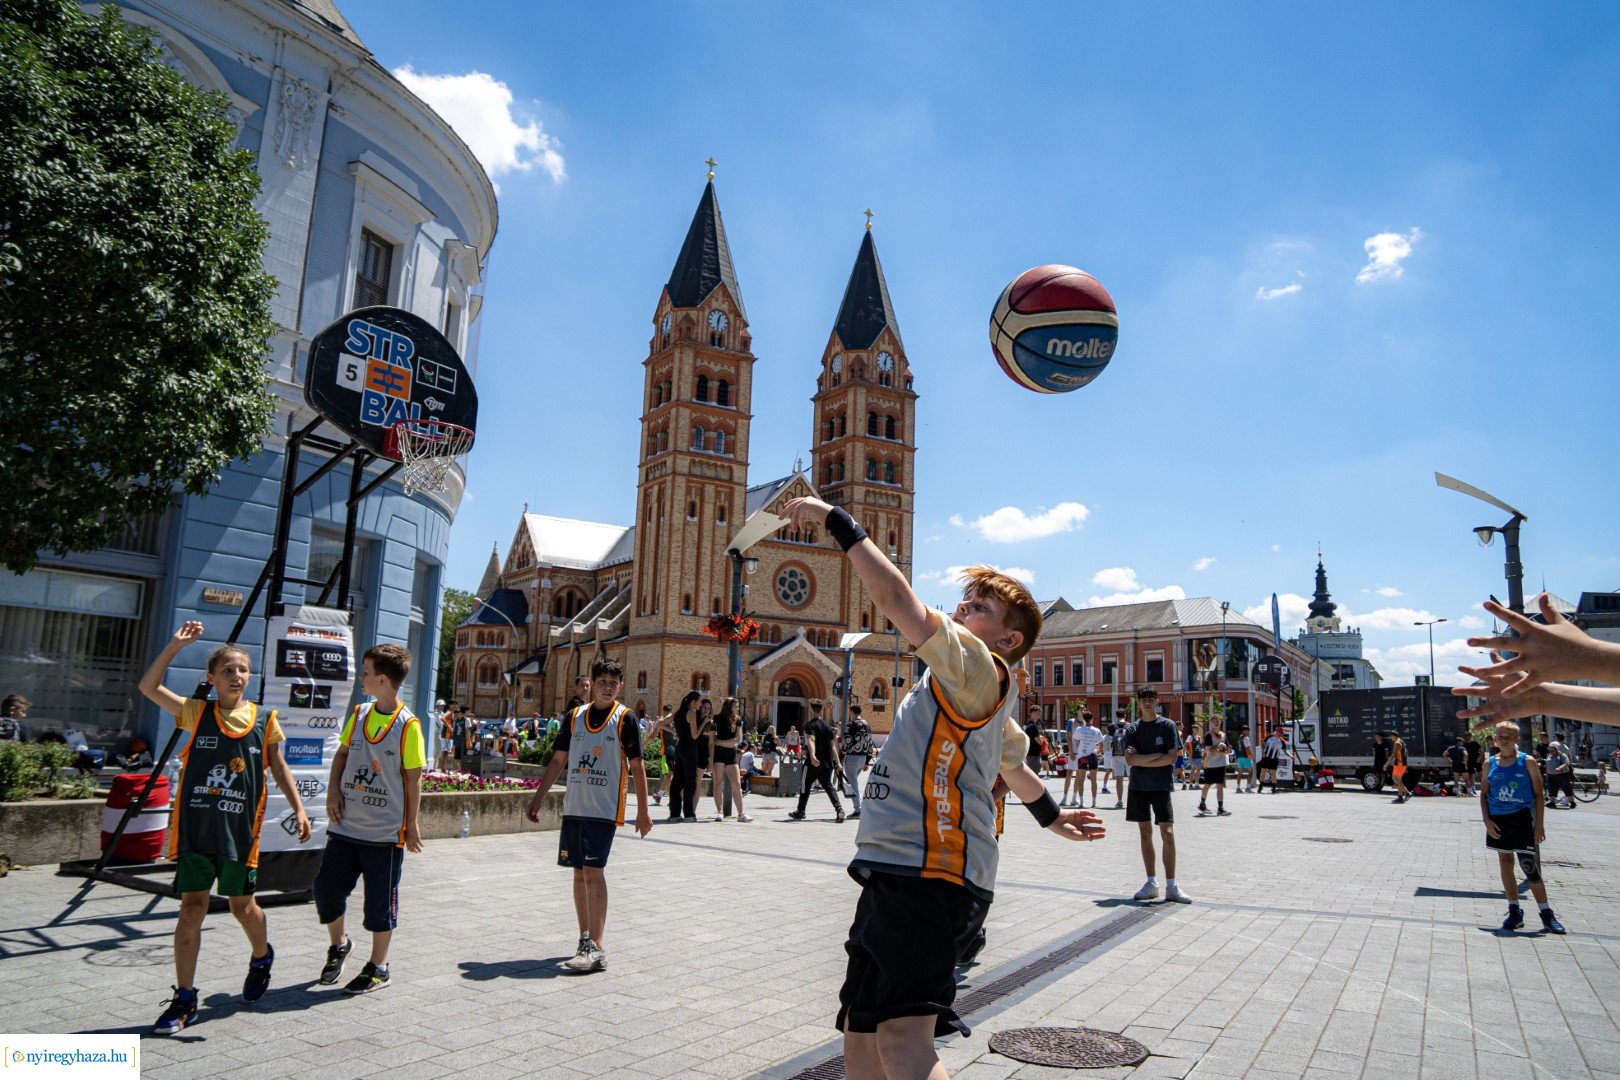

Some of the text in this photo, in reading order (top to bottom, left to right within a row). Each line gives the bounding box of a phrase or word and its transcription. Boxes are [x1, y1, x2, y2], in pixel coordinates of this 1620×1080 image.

[345, 318, 414, 369] STR
[345, 363, 358, 381] 5
[289, 745, 320, 754] molten
